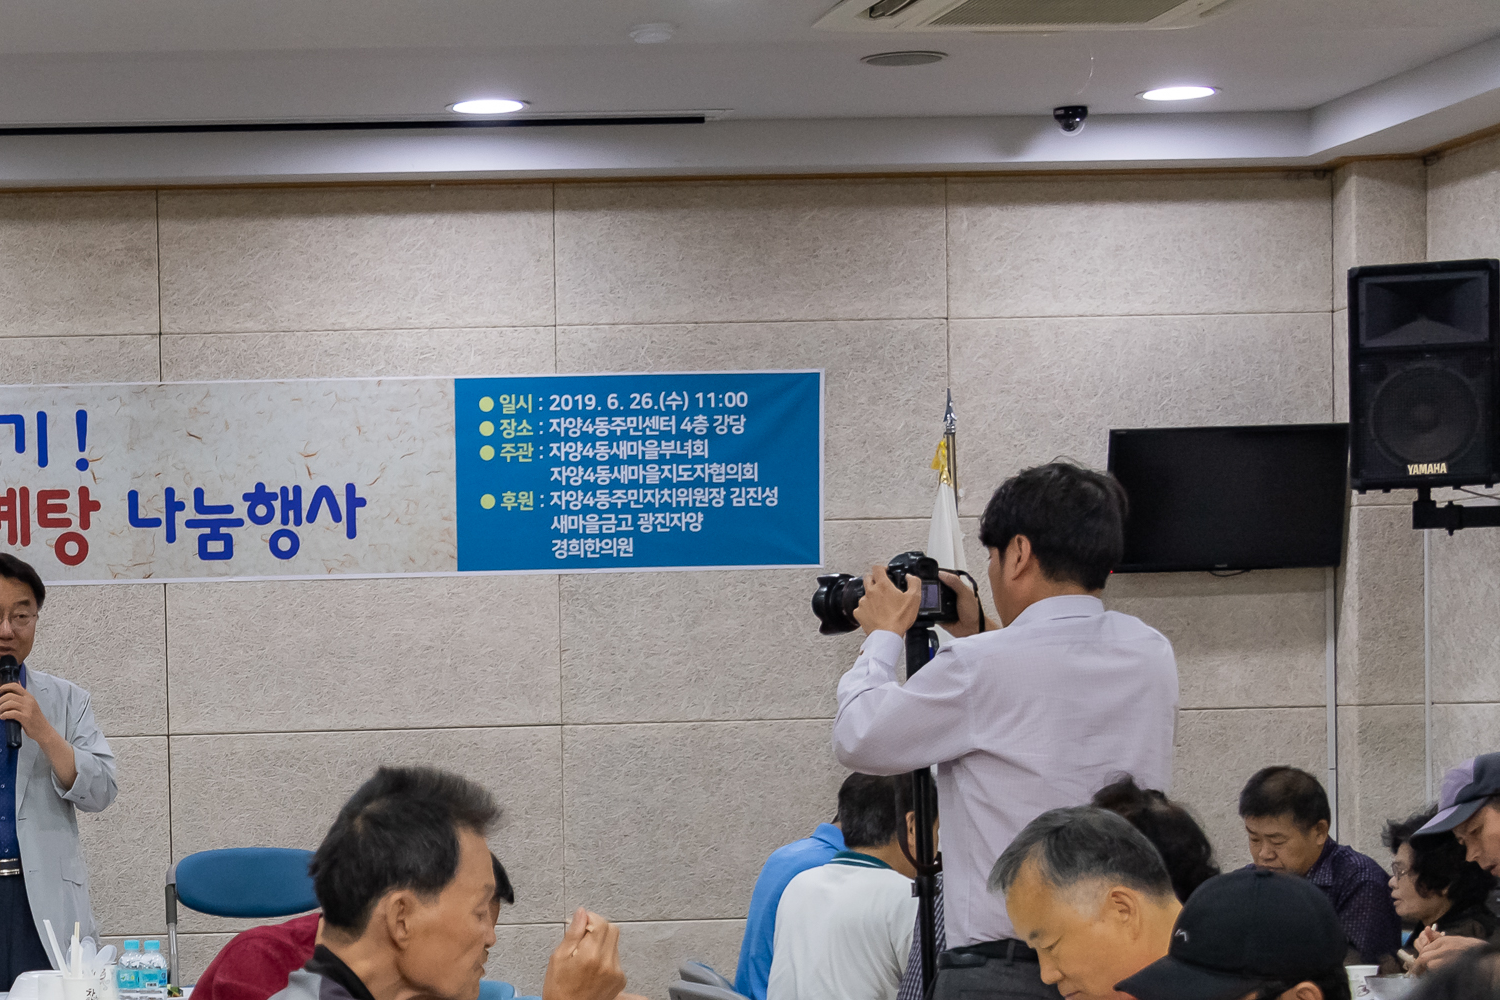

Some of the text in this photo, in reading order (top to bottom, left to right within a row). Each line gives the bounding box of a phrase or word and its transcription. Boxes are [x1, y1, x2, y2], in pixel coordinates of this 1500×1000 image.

[500, 394, 532, 414] 일시
[550, 394, 601, 410] 2019.
[608, 394, 623, 409] 6.
[696, 392, 747, 407] 11:00
[500, 419, 533, 438] 장소
[550, 416, 675, 437] 자양4동주민센터
[681, 415, 709, 434] 4층
[714, 415, 746, 434] 강당
[500, 443, 533, 462] 주관
[550, 439, 708, 461] 자양4동새마을부녀회
[551, 463, 757, 485] 자양4동새마을지도자협의회
[1408, 463, 1447, 475] YAMAHA
[501, 491, 533, 510] 후원
[550, 488, 726, 510] 자양4동주민자치위원장
[731, 487, 777, 506] 김진성
[128, 483, 366, 560] 나눔행사
[551, 512, 703, 533] 새마을금고 광진자양
[552, 538, 633, 558] 경희한의원
